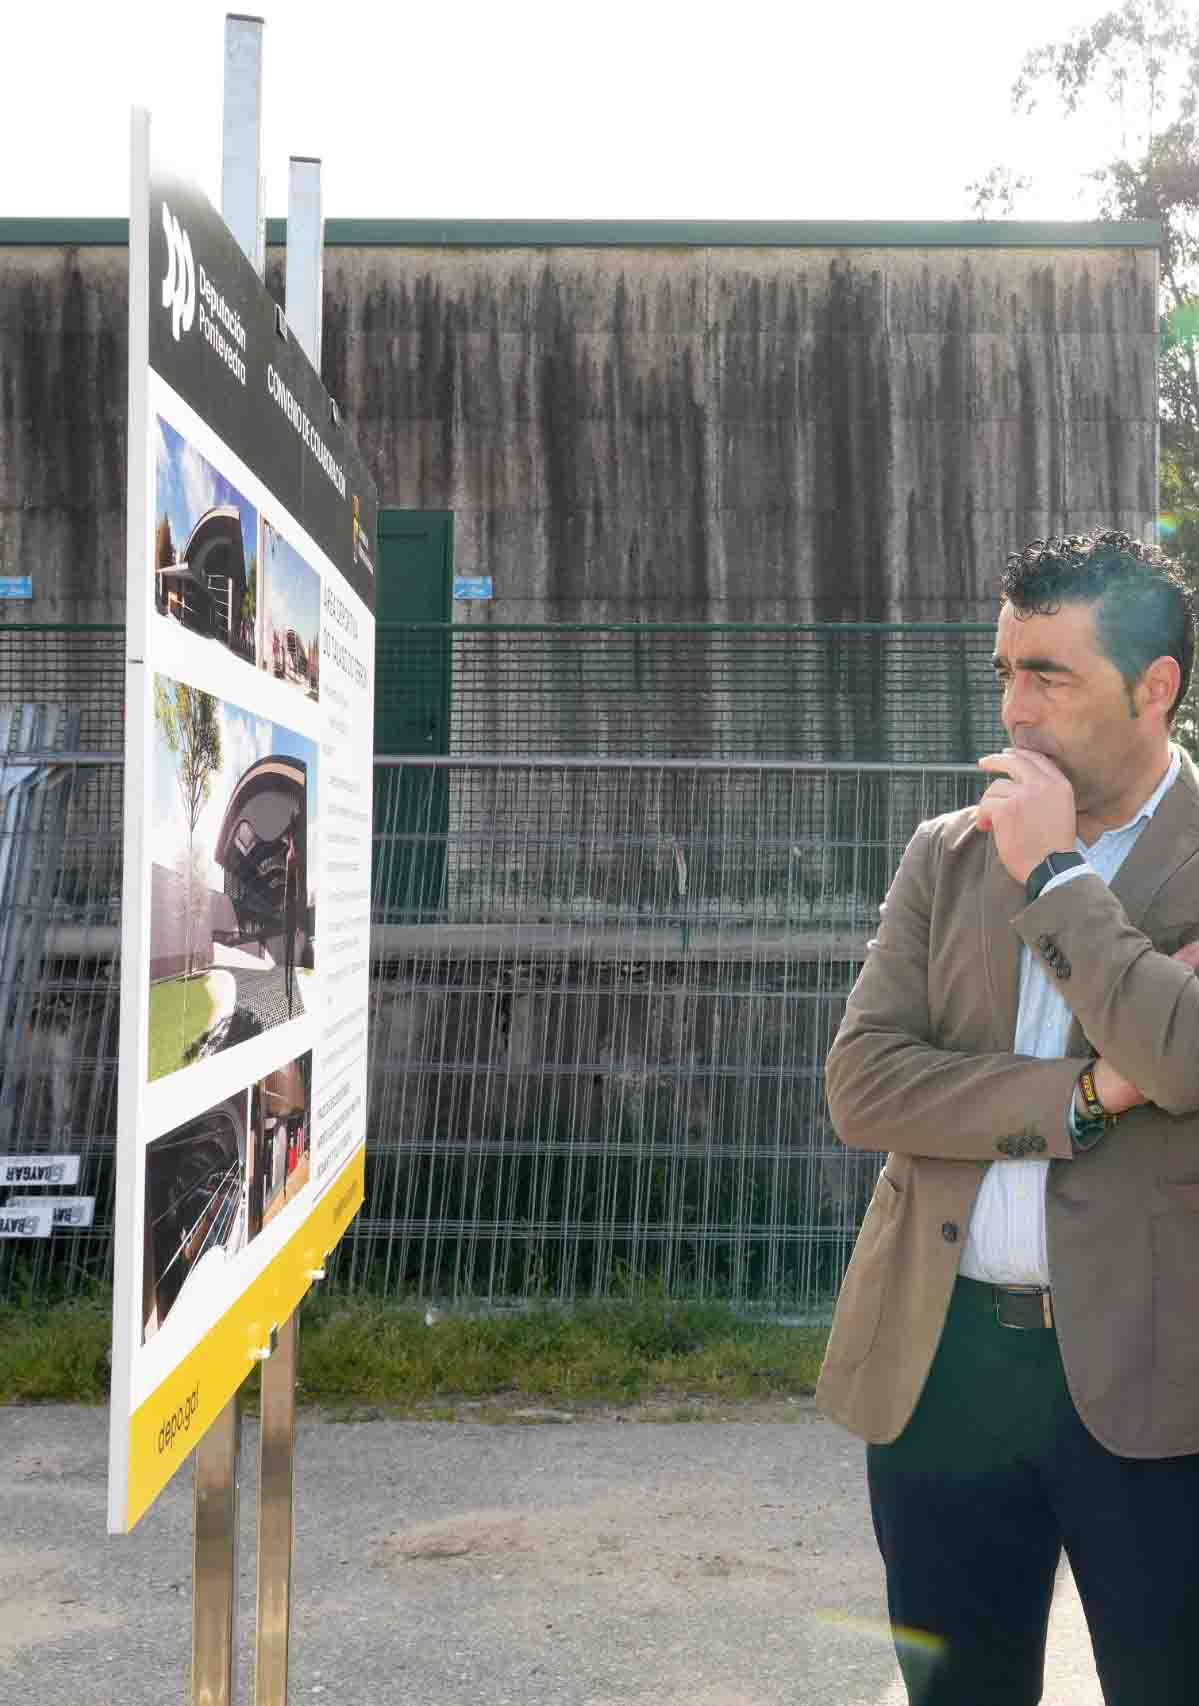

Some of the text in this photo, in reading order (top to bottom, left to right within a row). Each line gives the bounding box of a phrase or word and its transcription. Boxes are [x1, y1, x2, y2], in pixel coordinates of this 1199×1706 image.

[200, 263, 246, 352] Deputación
[200, 303, 246, 385] Pontevedra
[267, 364, 346, 500] CONVENIO DE COLABORACIÓN
[158, 1380, 200, 1455] depo.gal
